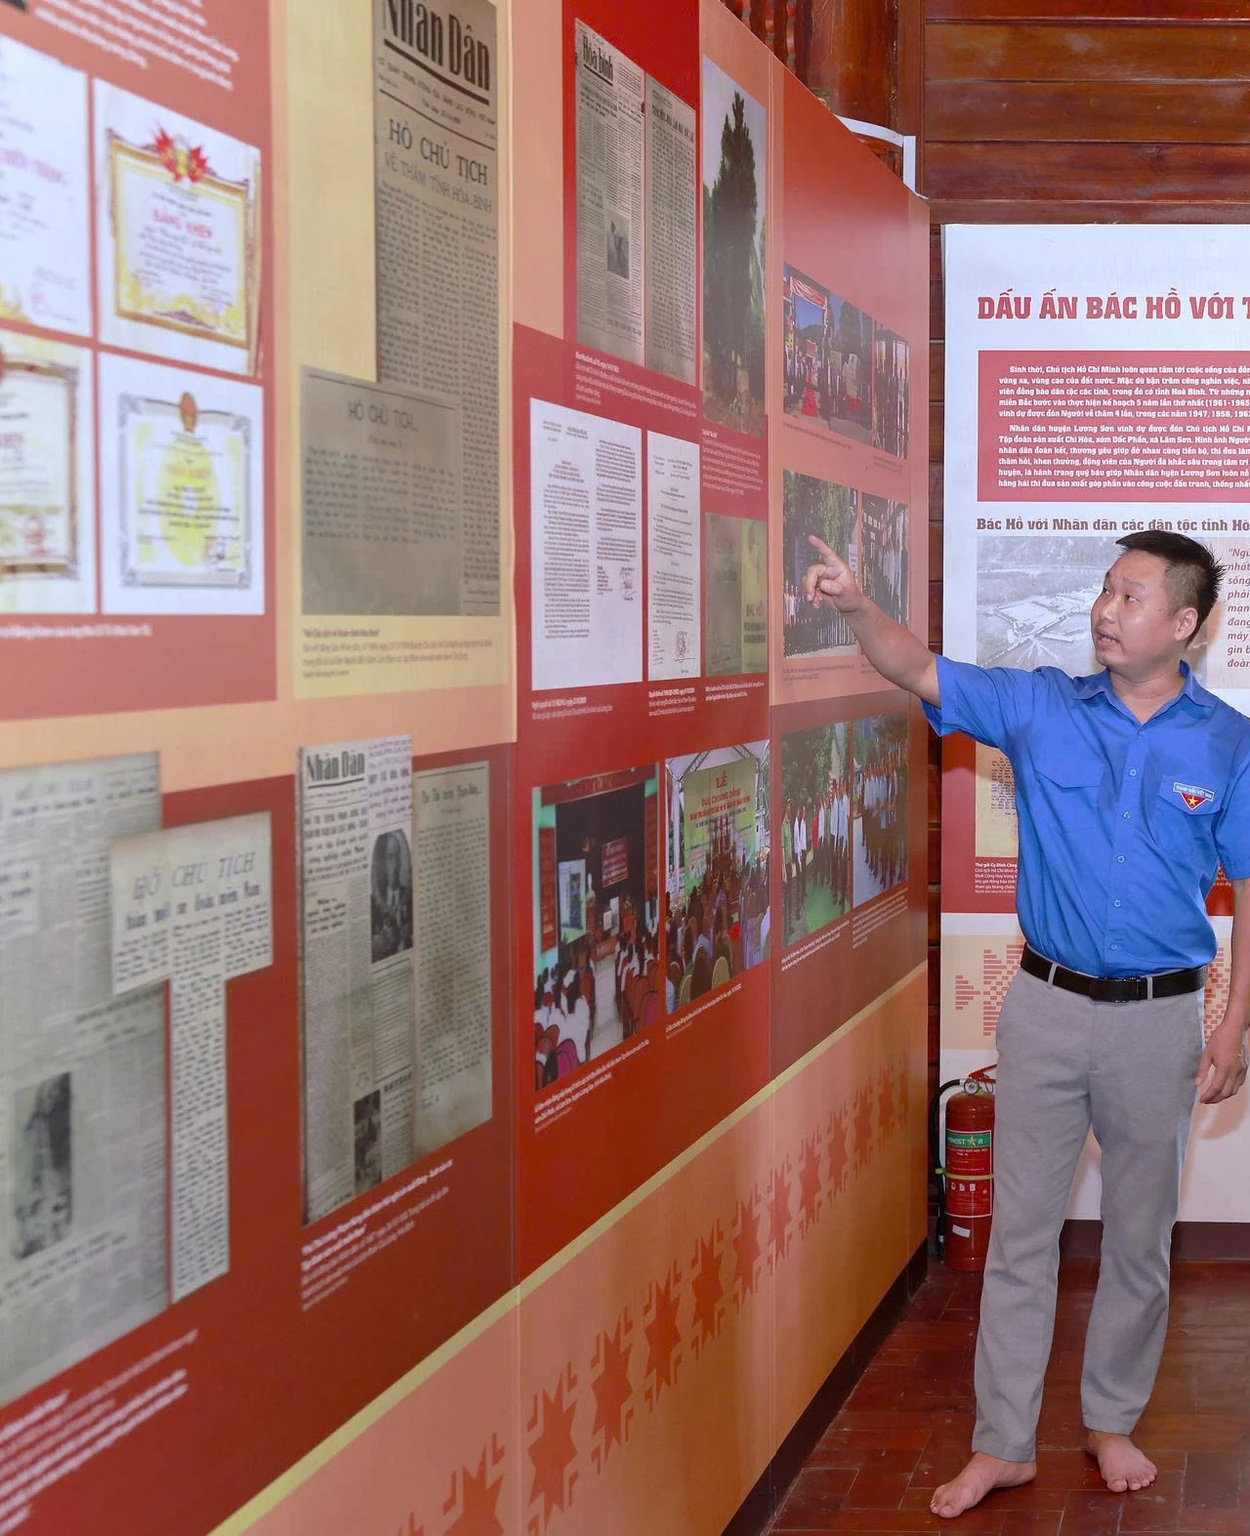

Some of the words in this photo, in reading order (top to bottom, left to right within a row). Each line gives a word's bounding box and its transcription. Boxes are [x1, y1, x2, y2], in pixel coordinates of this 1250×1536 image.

[448, 13, 490, 92] Dân
[420, 137, 450, 169] CHỦ
[456, 155, 488, 186] TỊCH
[977, 287, 1032, 320] DẤU
[1038, 287, 1078, 320] ẤN
[1085, 291, 1137, 319] BÁC
[1145, 286, 1181, 319] HỒ
[1188, 291, 1234, 319] VỚI
[976, 517, 1002, 530] Bác
[1005, 515, 1023, 530] Hồ
[1026, 518, 1048, 530] với
[1052, 518, 1088, 530] Nhân
[1092, 518, 1117, 530] dân
[1121, 518, 1148, 531] các
[1176, 518, 1198, 534] tộc
[1201, 518, 1228, 531] tỉnh
